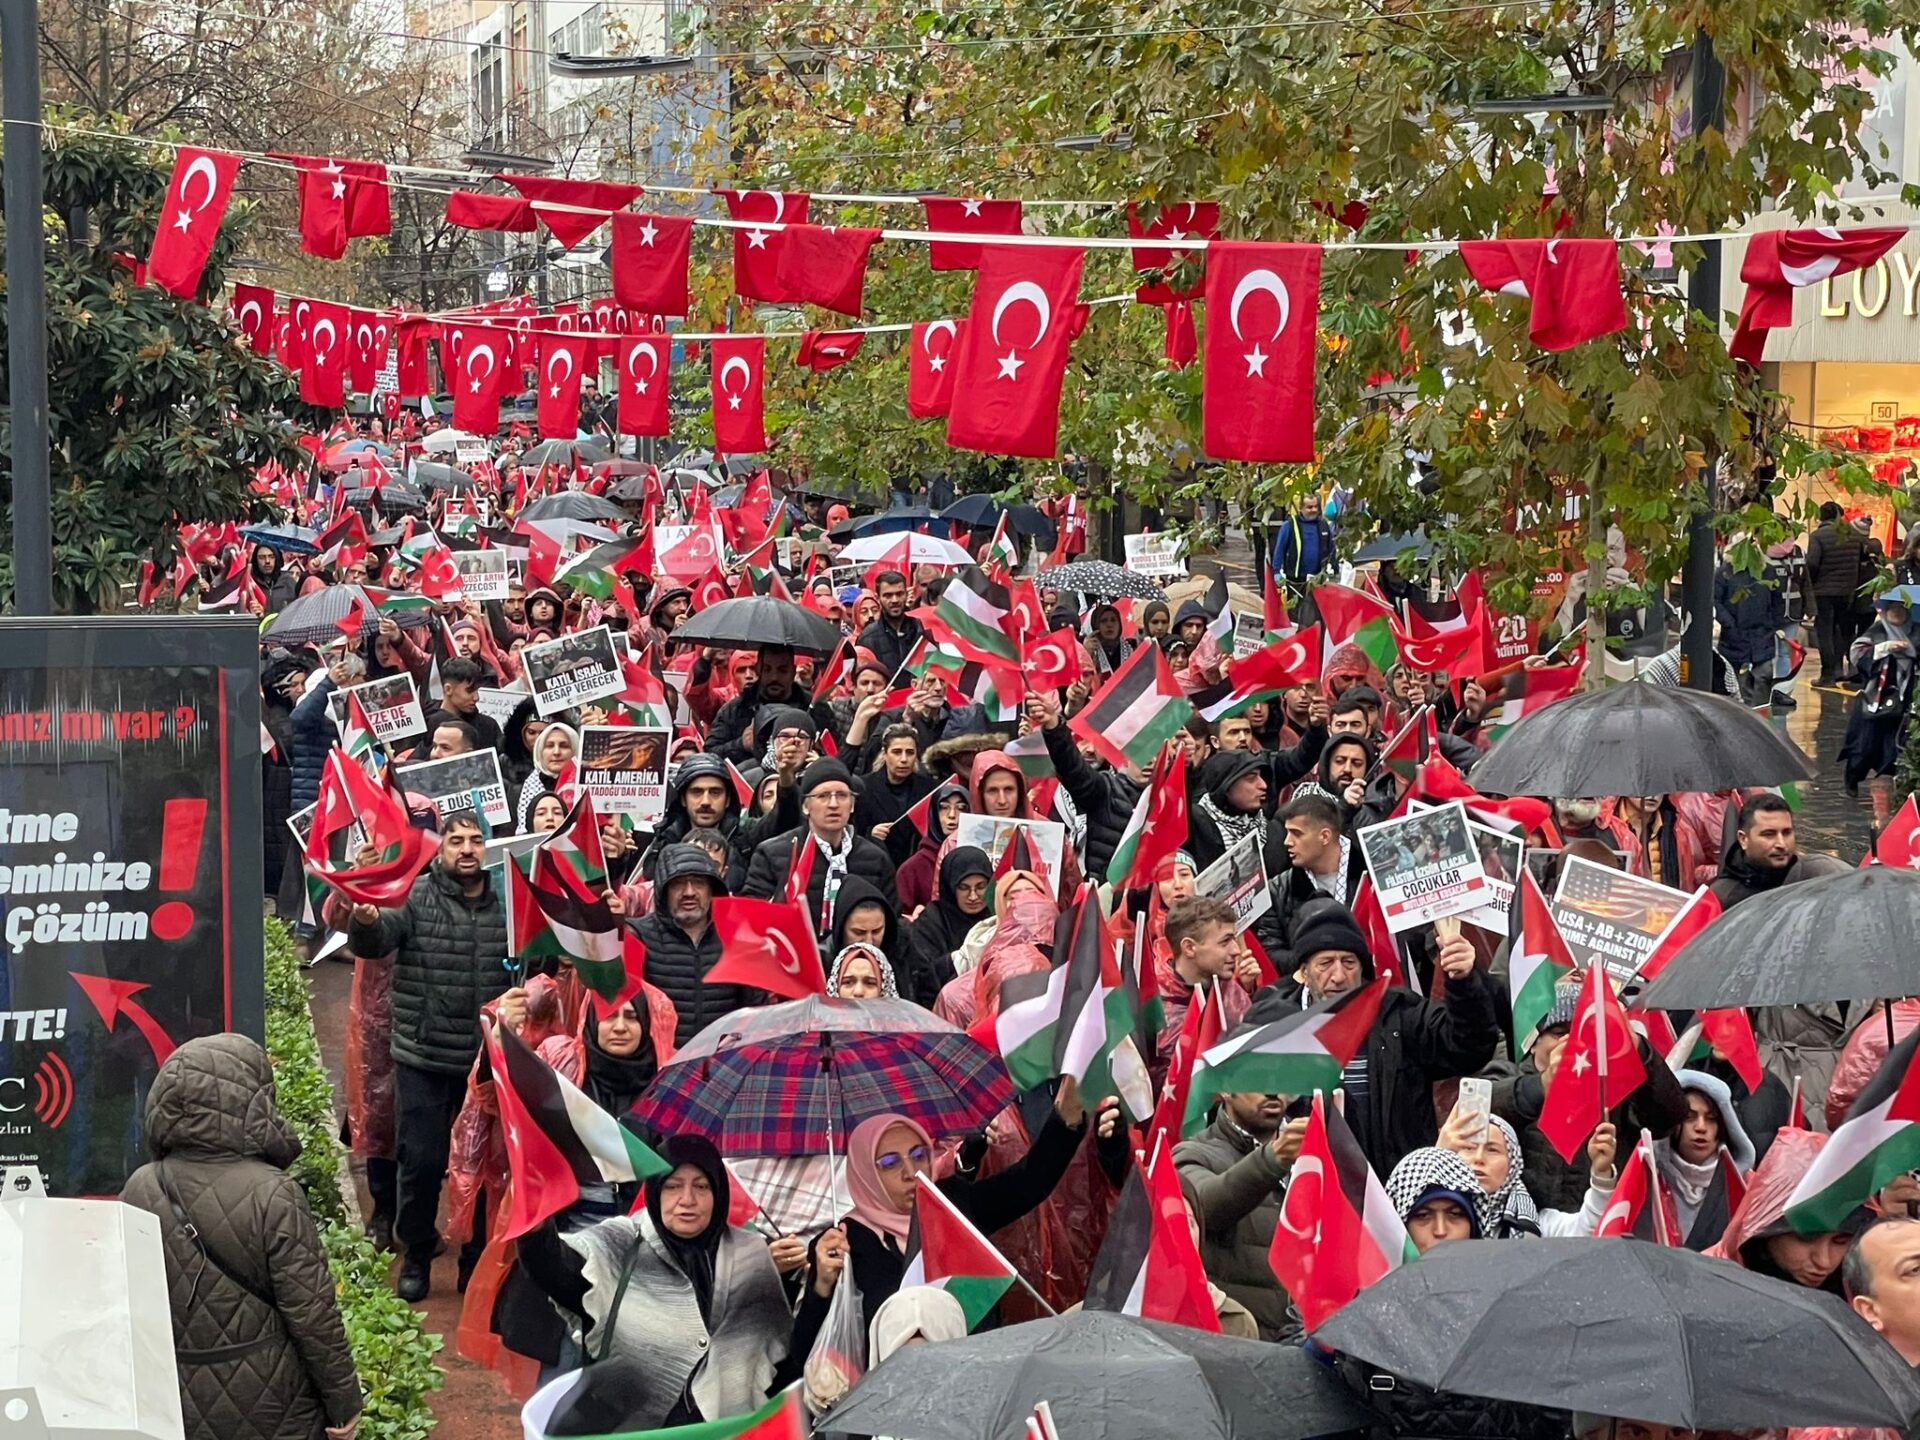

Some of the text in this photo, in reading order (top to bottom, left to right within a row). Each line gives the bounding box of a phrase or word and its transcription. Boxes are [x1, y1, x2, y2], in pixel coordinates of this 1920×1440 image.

[1878, 406, 1893, 418] 50
[1498, 615, 1527, 643] 20
[541, 672, 618, 704] HESAP VERECEK
[545, 662, 607, 691] KATİL İSRAİL
[112, 710, 165, 740] var
[175, 706, 195, 738] ?
[369, 706, 407, 726] ZE'DE
[395, 717, 414, 730] VAR
[584, 768, 659, 784] KATİL AMERİKA
[447, 786, 503, 811] DÜŞRSE
[637, 787, 660, 797] DEFOL
[1402, 869, 1462, 900] ÇOCUKLAR
[5, 901, 149, 954] Çözüm
[1587, 936, 1636, 962] AGAINST
